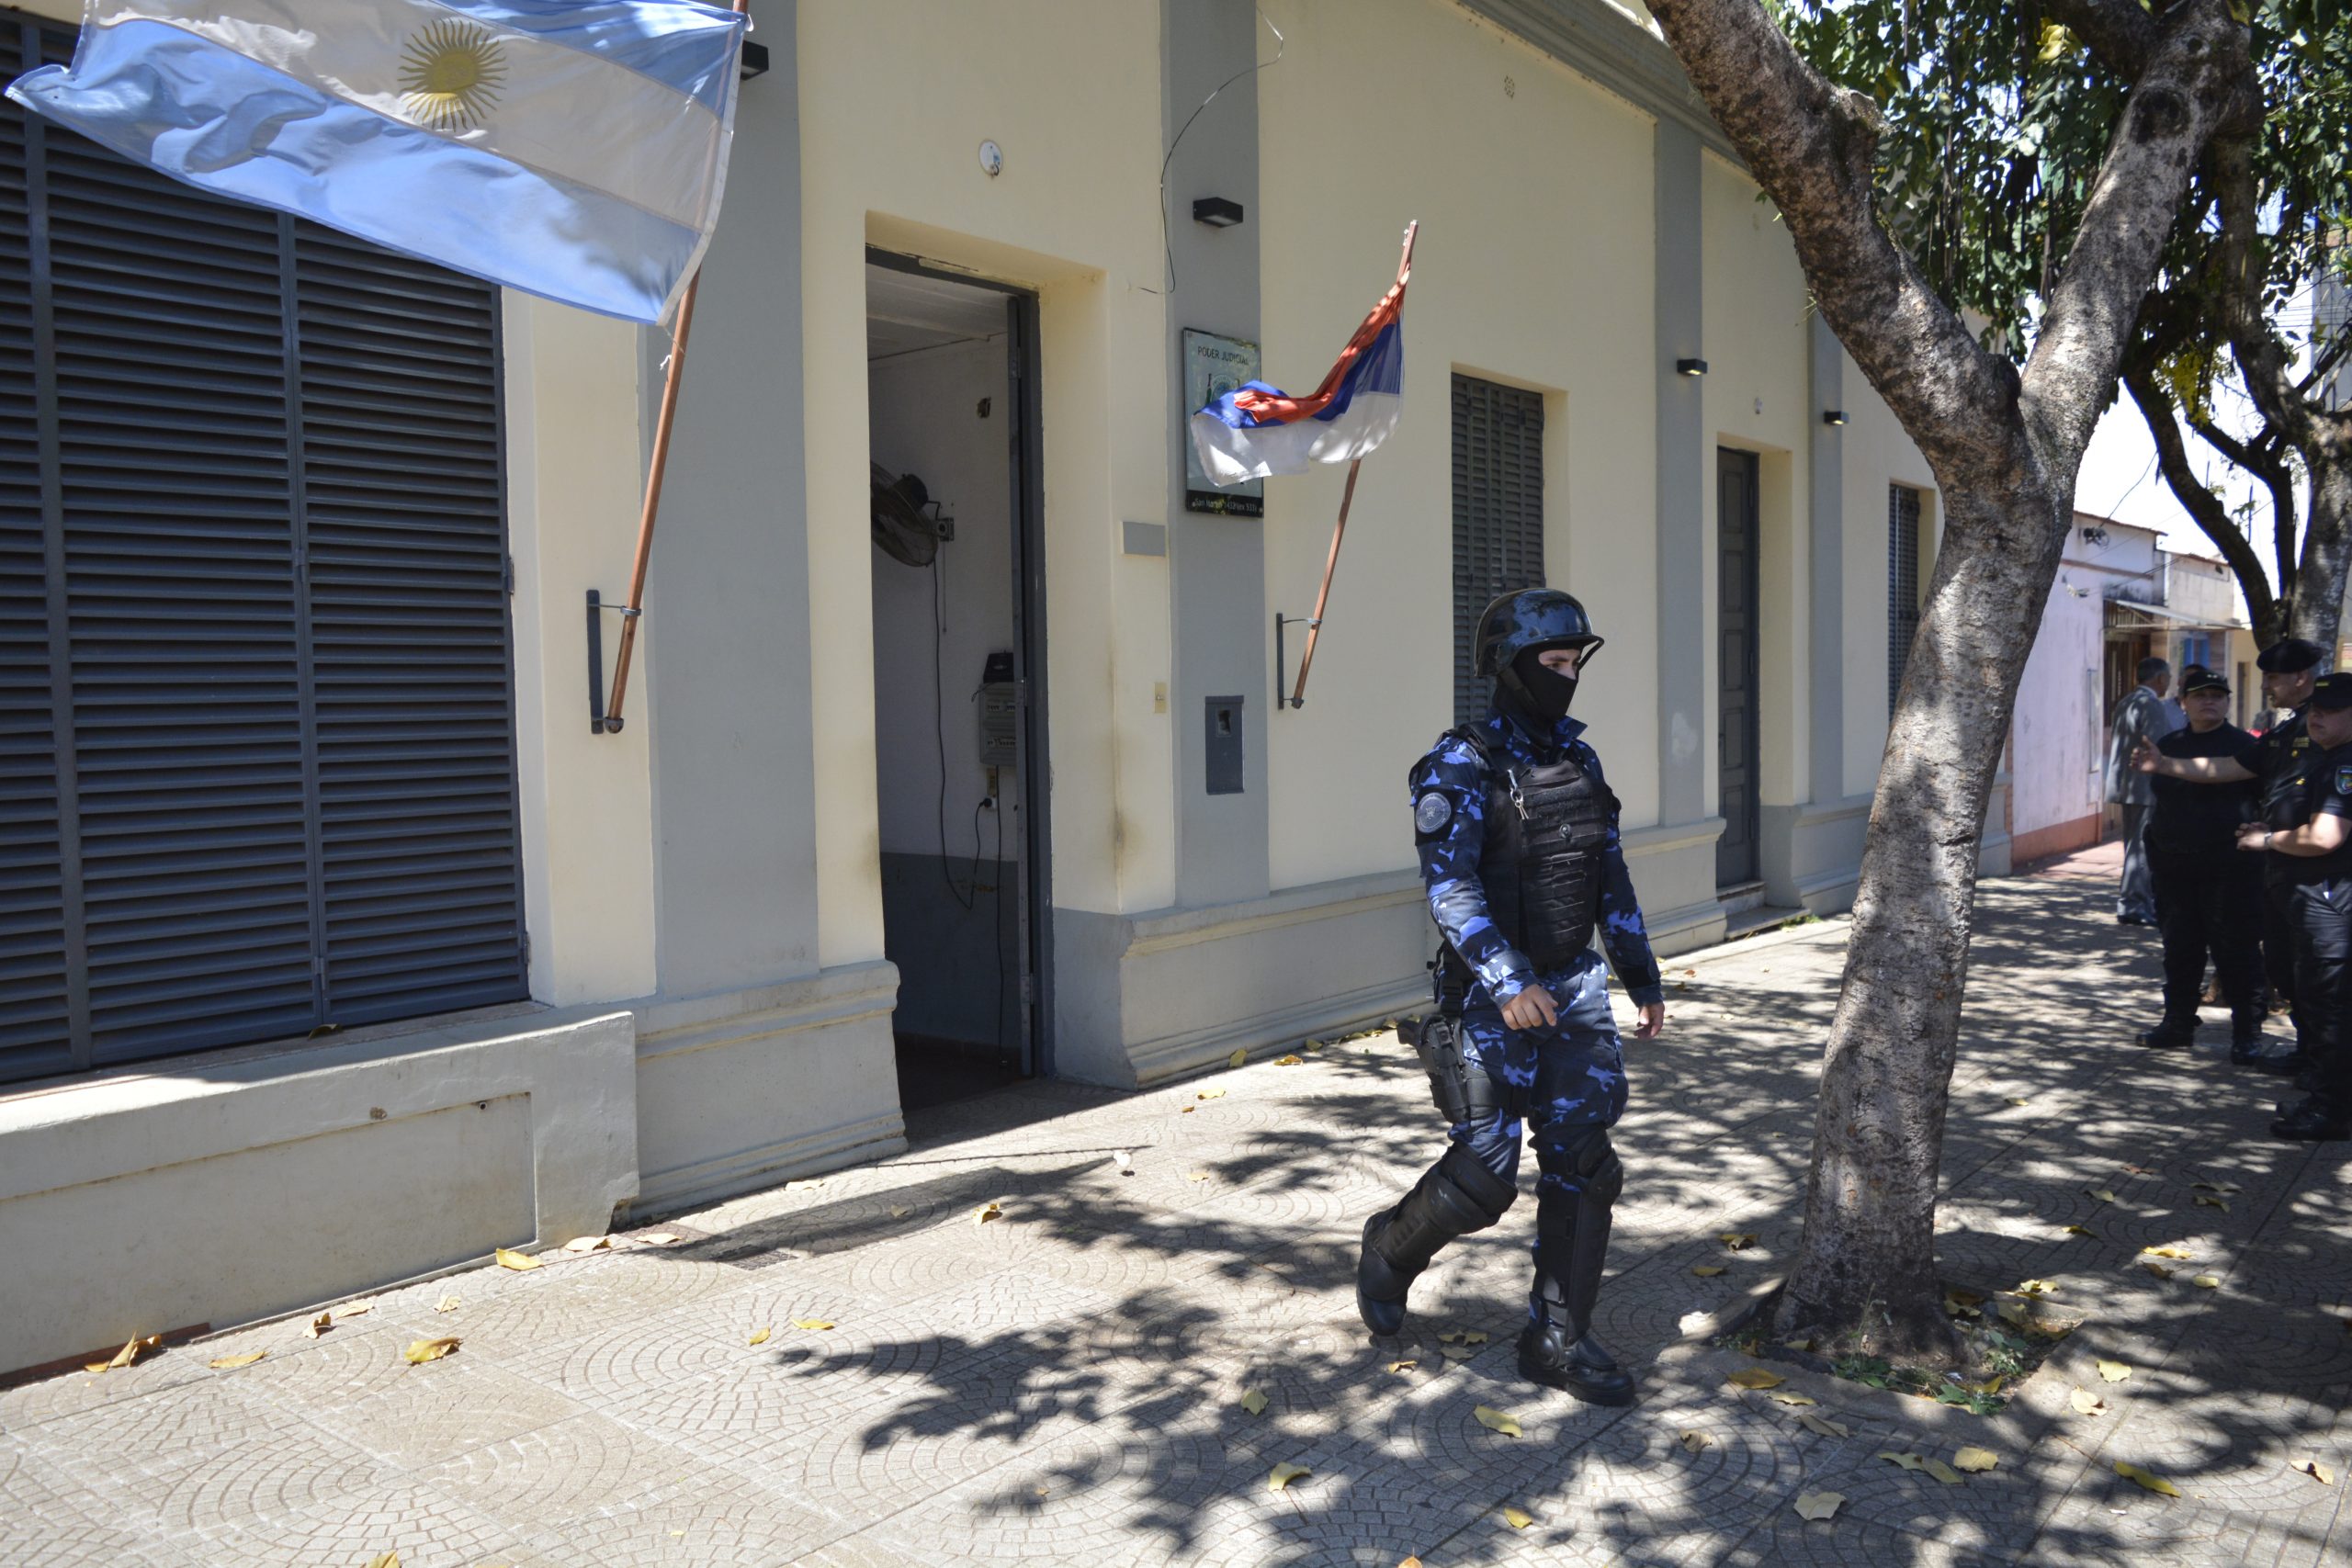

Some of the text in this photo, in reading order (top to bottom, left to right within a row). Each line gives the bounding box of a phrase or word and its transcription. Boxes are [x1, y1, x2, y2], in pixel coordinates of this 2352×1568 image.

[1197, 345, 1250, 366] PODER JUDICIAL
[1194, 498, 1205, 507] San
